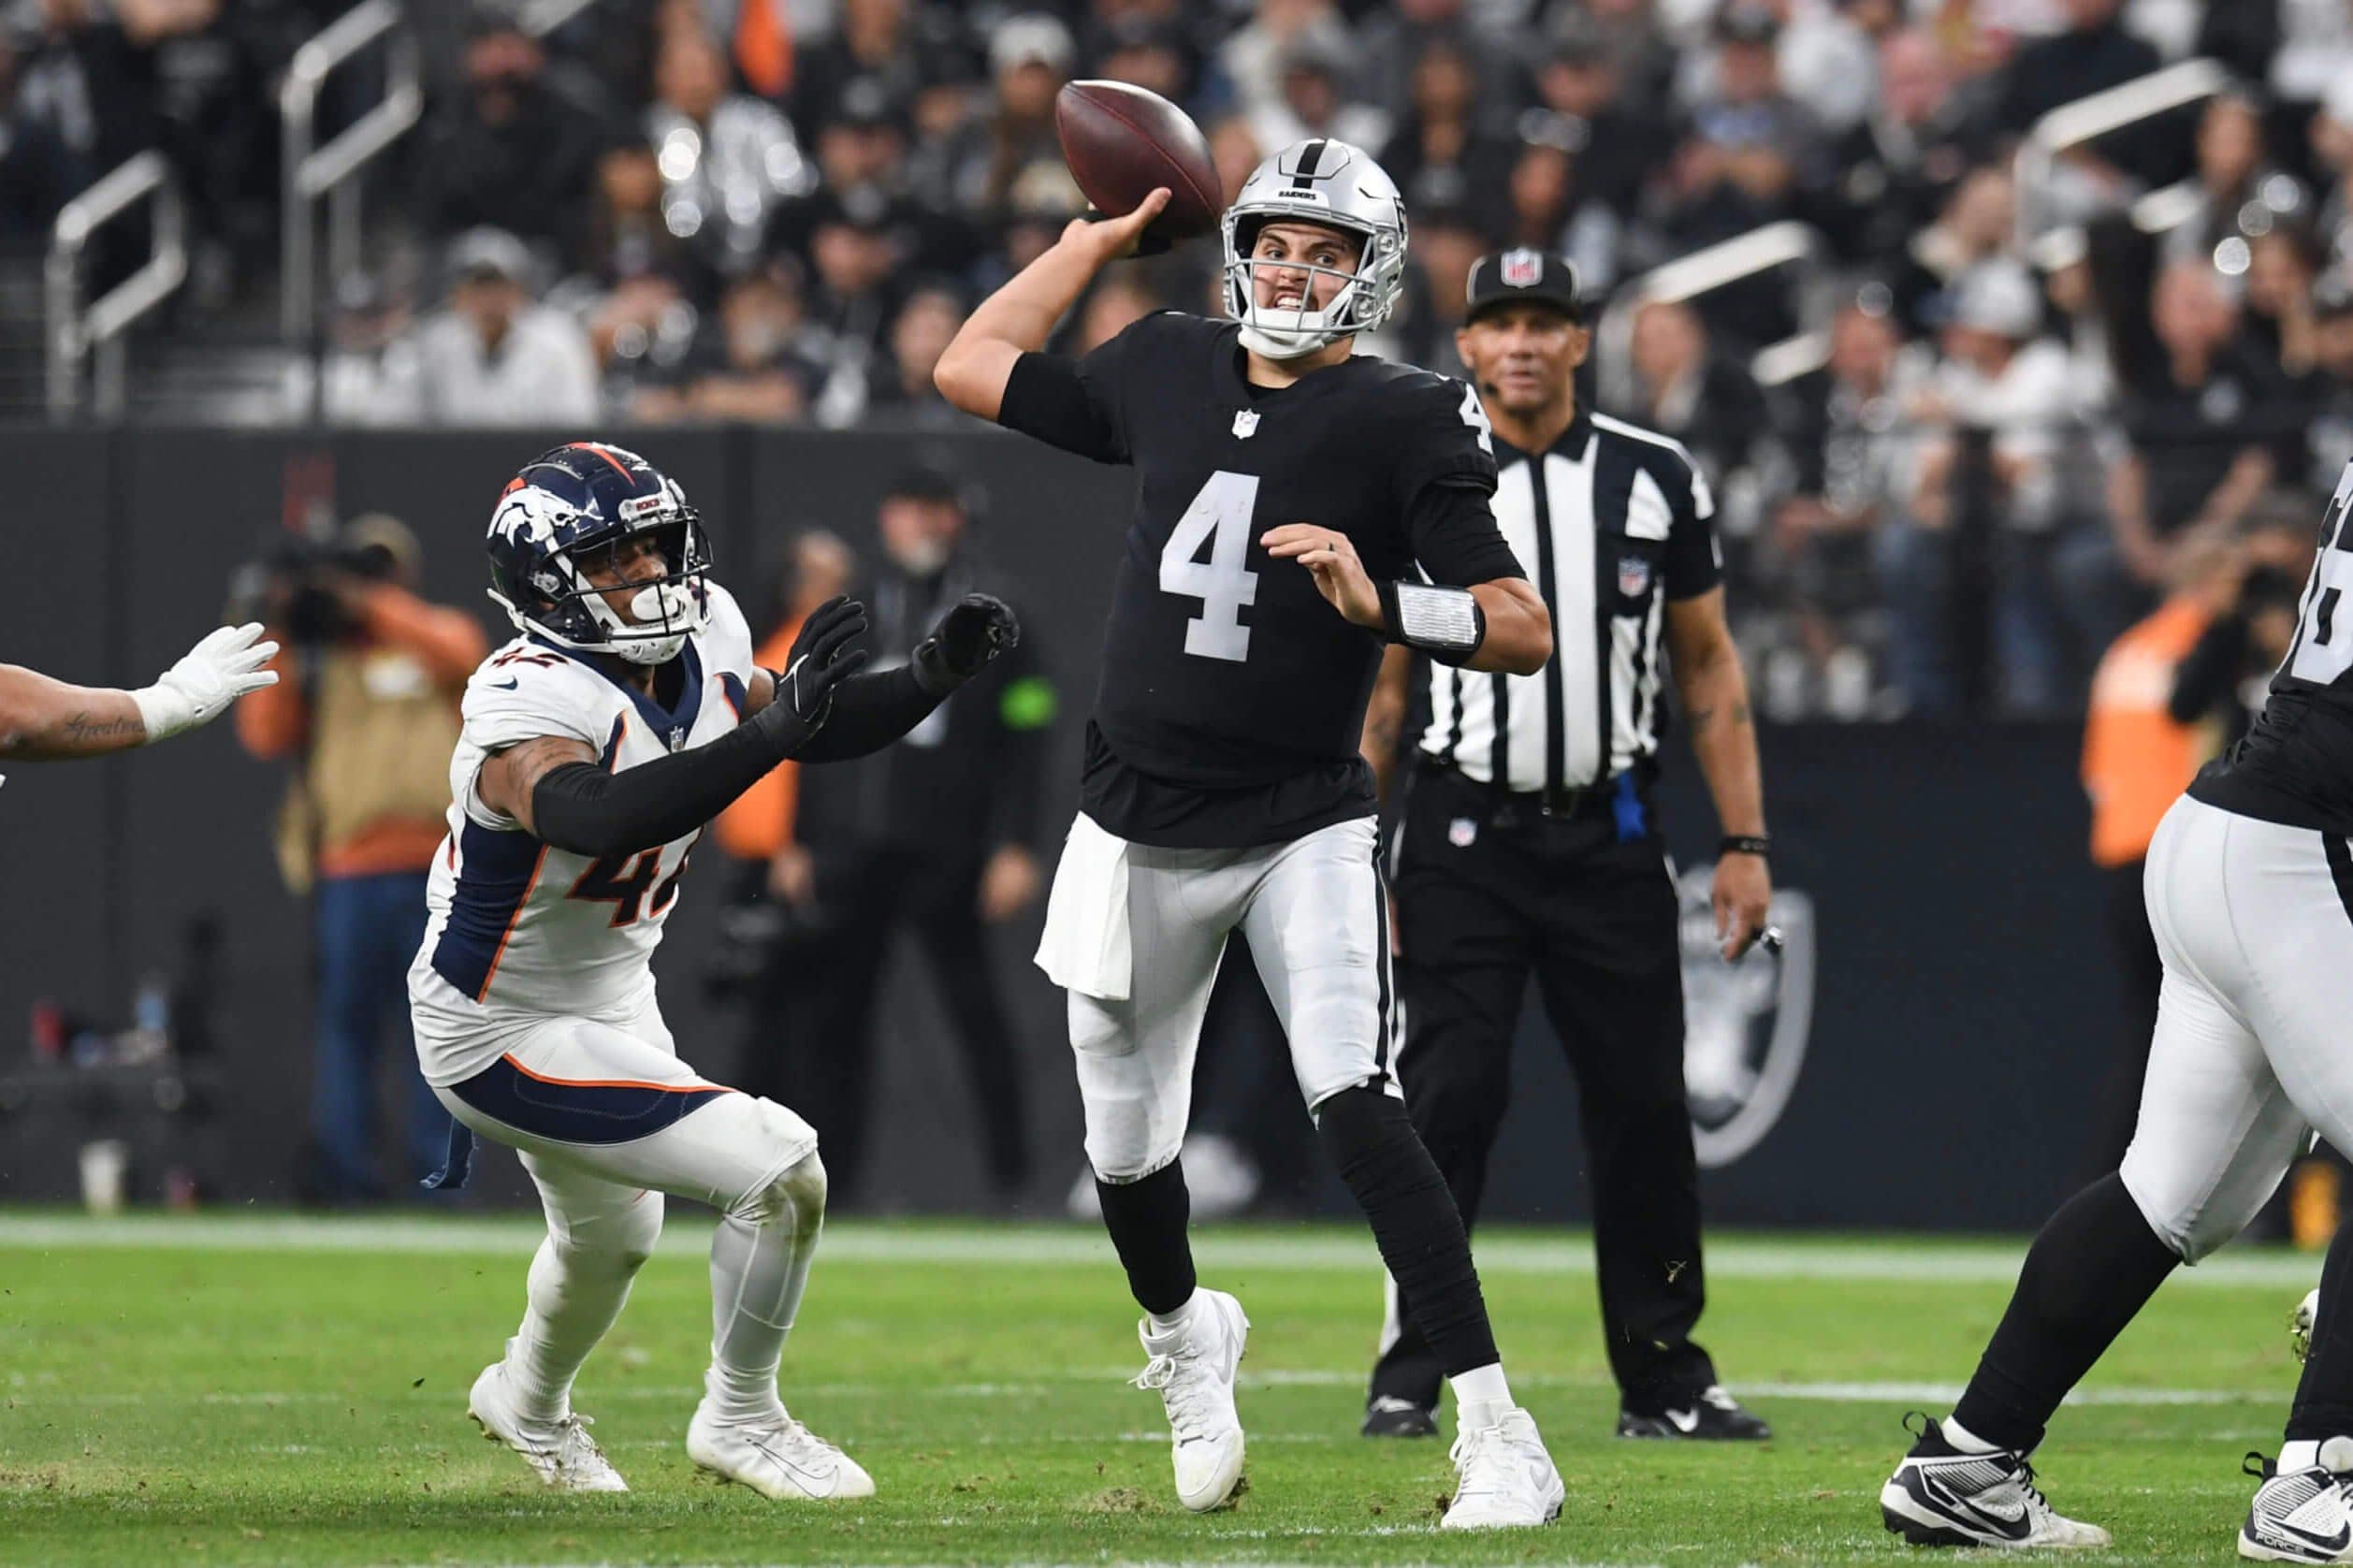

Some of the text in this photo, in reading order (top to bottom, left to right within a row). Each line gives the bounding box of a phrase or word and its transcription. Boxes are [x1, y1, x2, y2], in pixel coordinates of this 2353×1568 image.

[1458, 382, 1494, 456] 4
[1159, 470, 1260, 662] 4
[2255, 1532, 2304, 1555] FORCE
